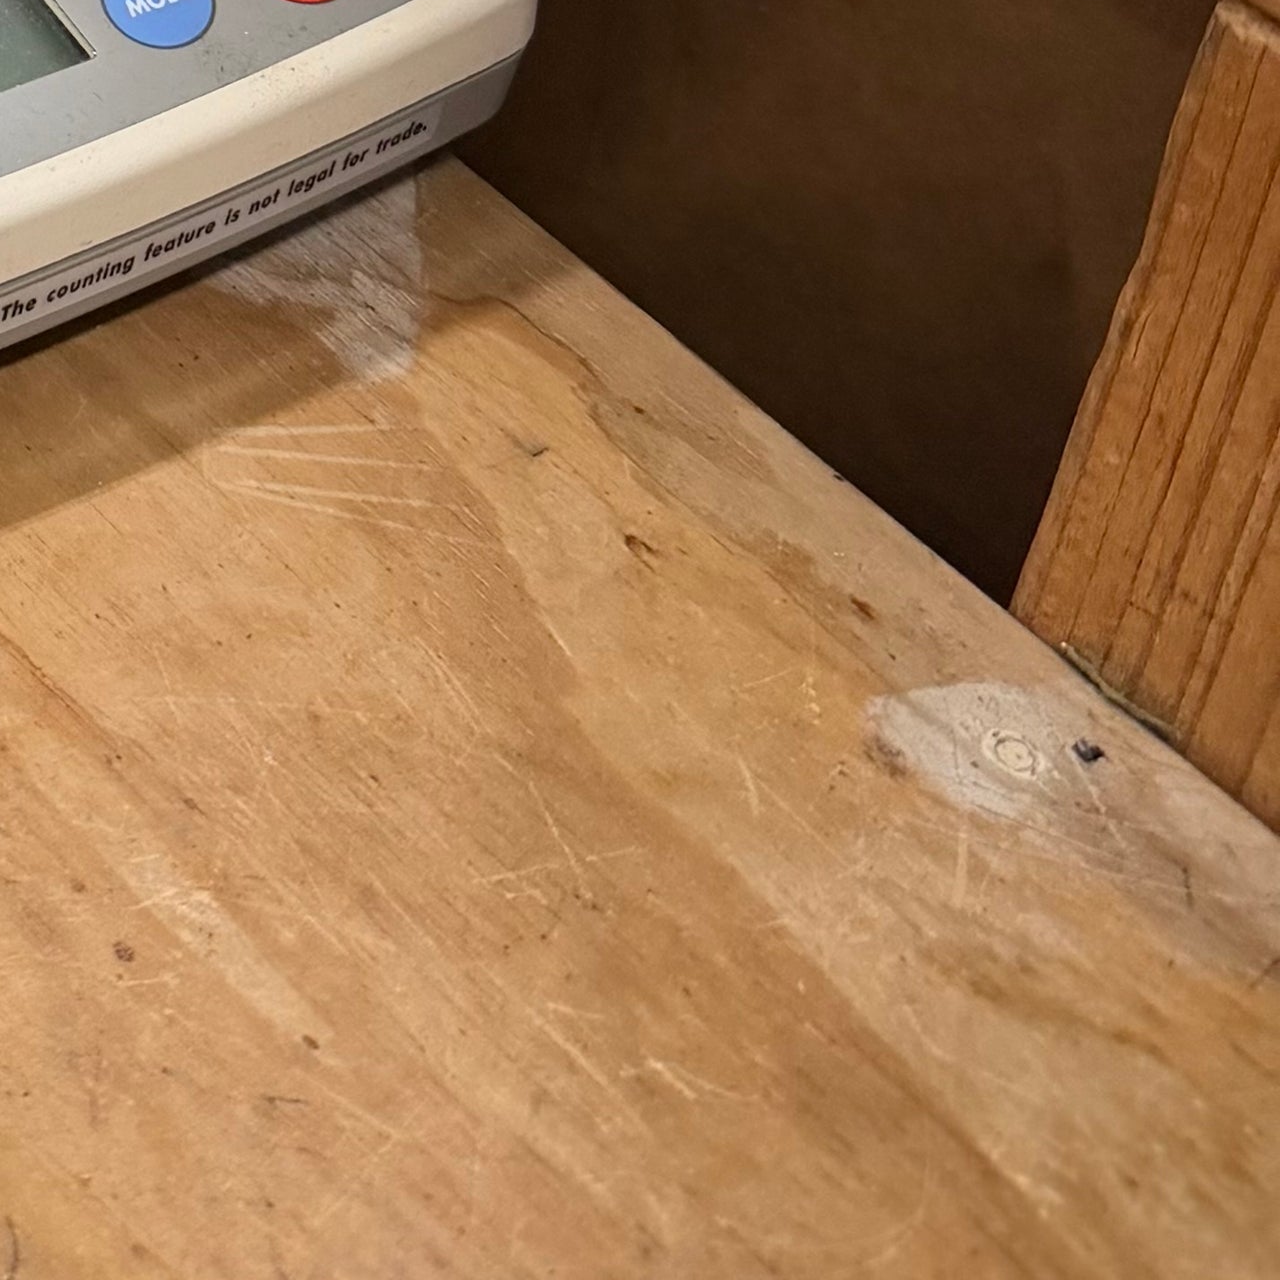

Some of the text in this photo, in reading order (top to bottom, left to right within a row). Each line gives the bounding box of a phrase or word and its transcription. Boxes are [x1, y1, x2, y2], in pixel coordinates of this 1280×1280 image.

[0, 119, 429, 324] The counting feature is not legal for trade.
